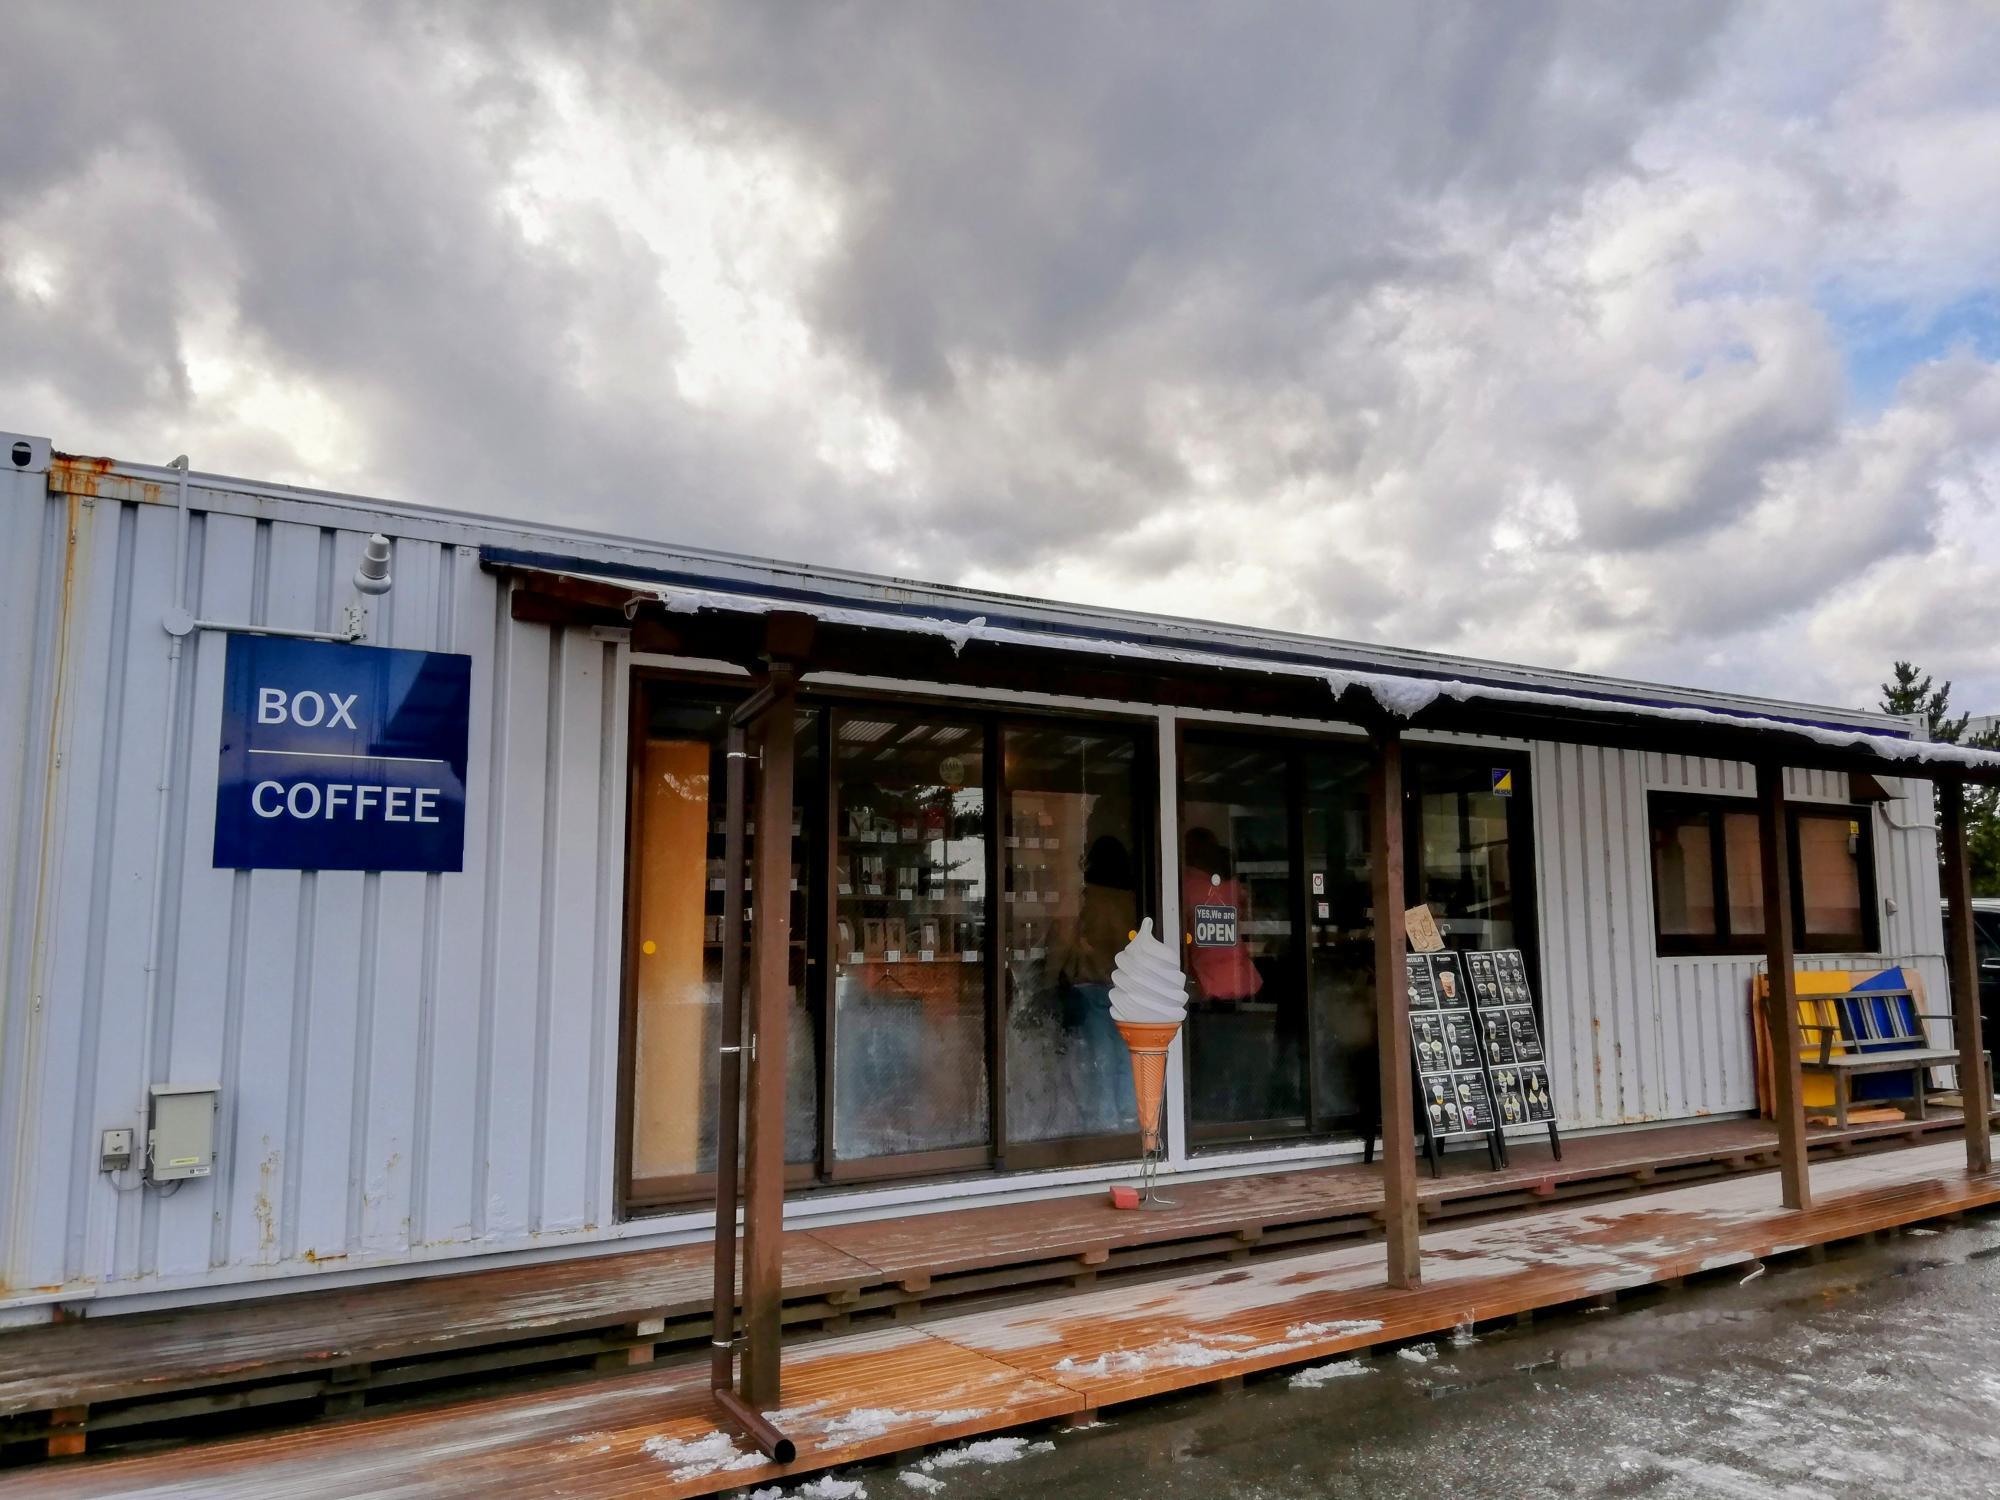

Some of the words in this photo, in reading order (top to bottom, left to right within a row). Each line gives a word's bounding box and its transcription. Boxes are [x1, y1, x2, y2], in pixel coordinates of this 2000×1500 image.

[257, 687, 358, 730] BOX
[251, 780, 441, 823] COFFEE
[1223, 911, 1235, 920] are
[1196, 922, 1235, 942] OPEN
